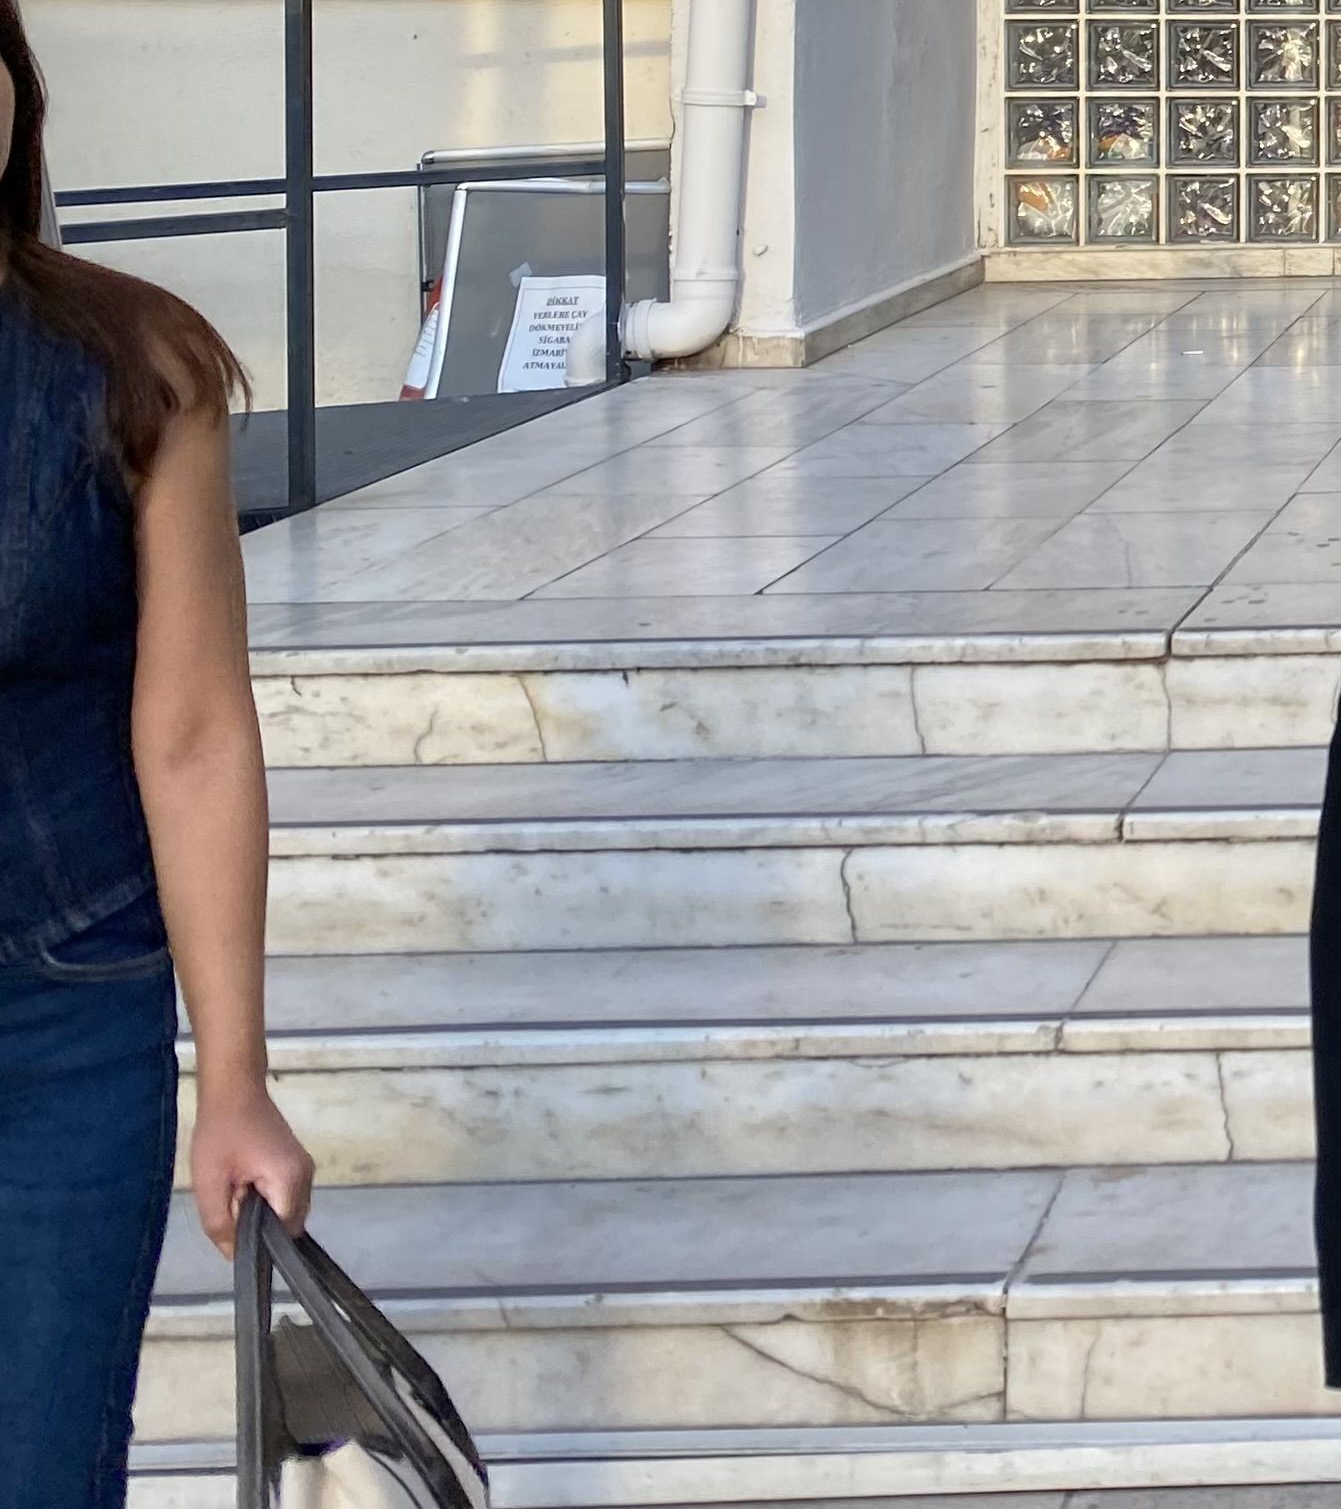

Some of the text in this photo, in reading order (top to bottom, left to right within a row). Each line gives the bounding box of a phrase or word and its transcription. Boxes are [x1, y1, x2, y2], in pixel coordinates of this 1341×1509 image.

[546, 296, 579, 306] DİKKAT
[533, 310, 588, 320] YERLERE ÇAY
[529, 322, 582, 332] DÖKMEYELİ
[538, 335, 571, 344] SİGARA
[522, 361, 566, 370] ATMAYAL
